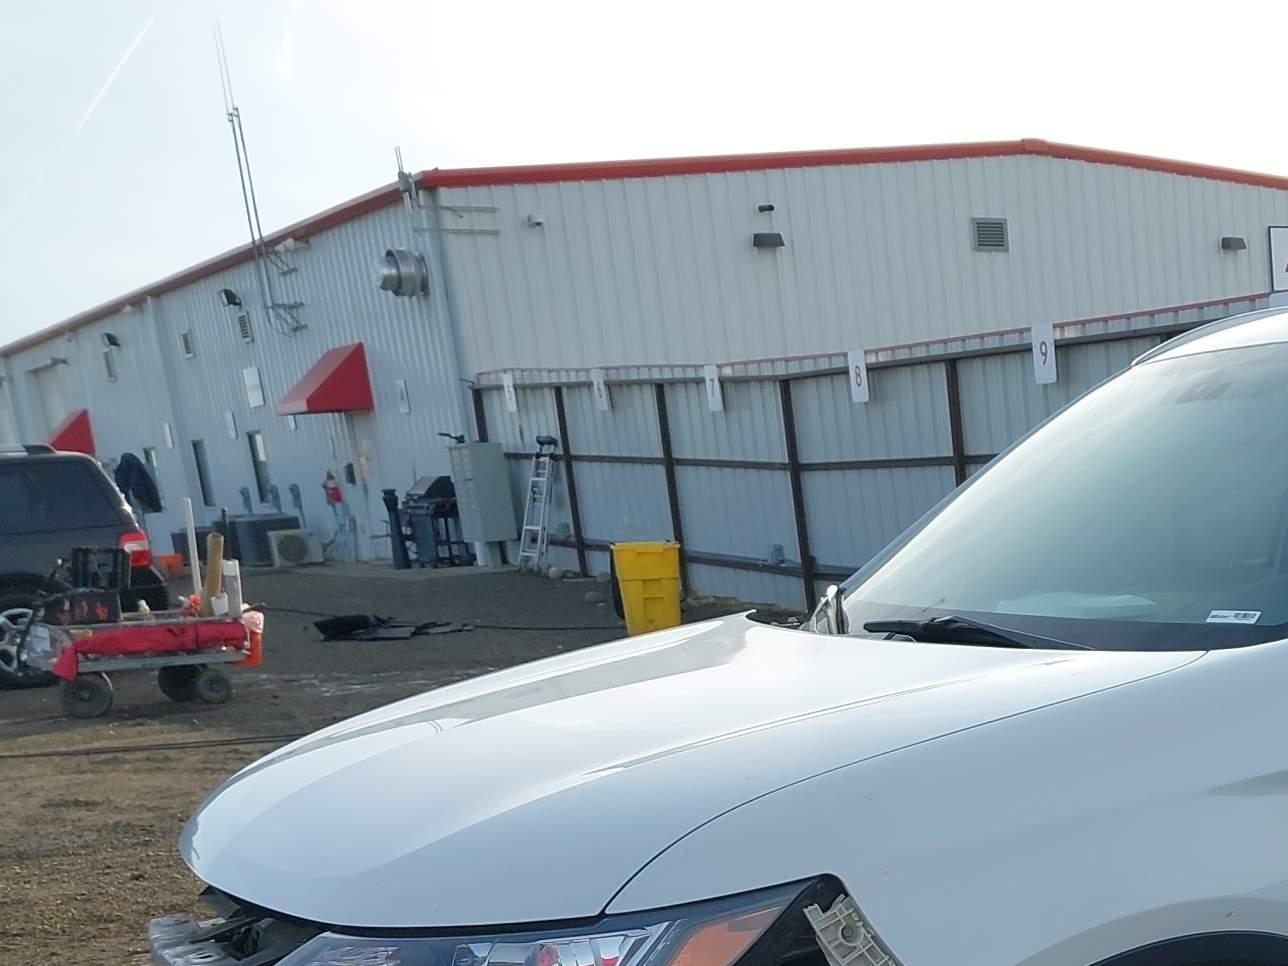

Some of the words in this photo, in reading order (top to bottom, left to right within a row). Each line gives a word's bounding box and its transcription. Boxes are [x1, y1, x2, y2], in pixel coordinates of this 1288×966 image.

[1039, 340, 1048, 366] 9
[855, 365, 862, 387] 8
[708, 378, 715, 398] 7
